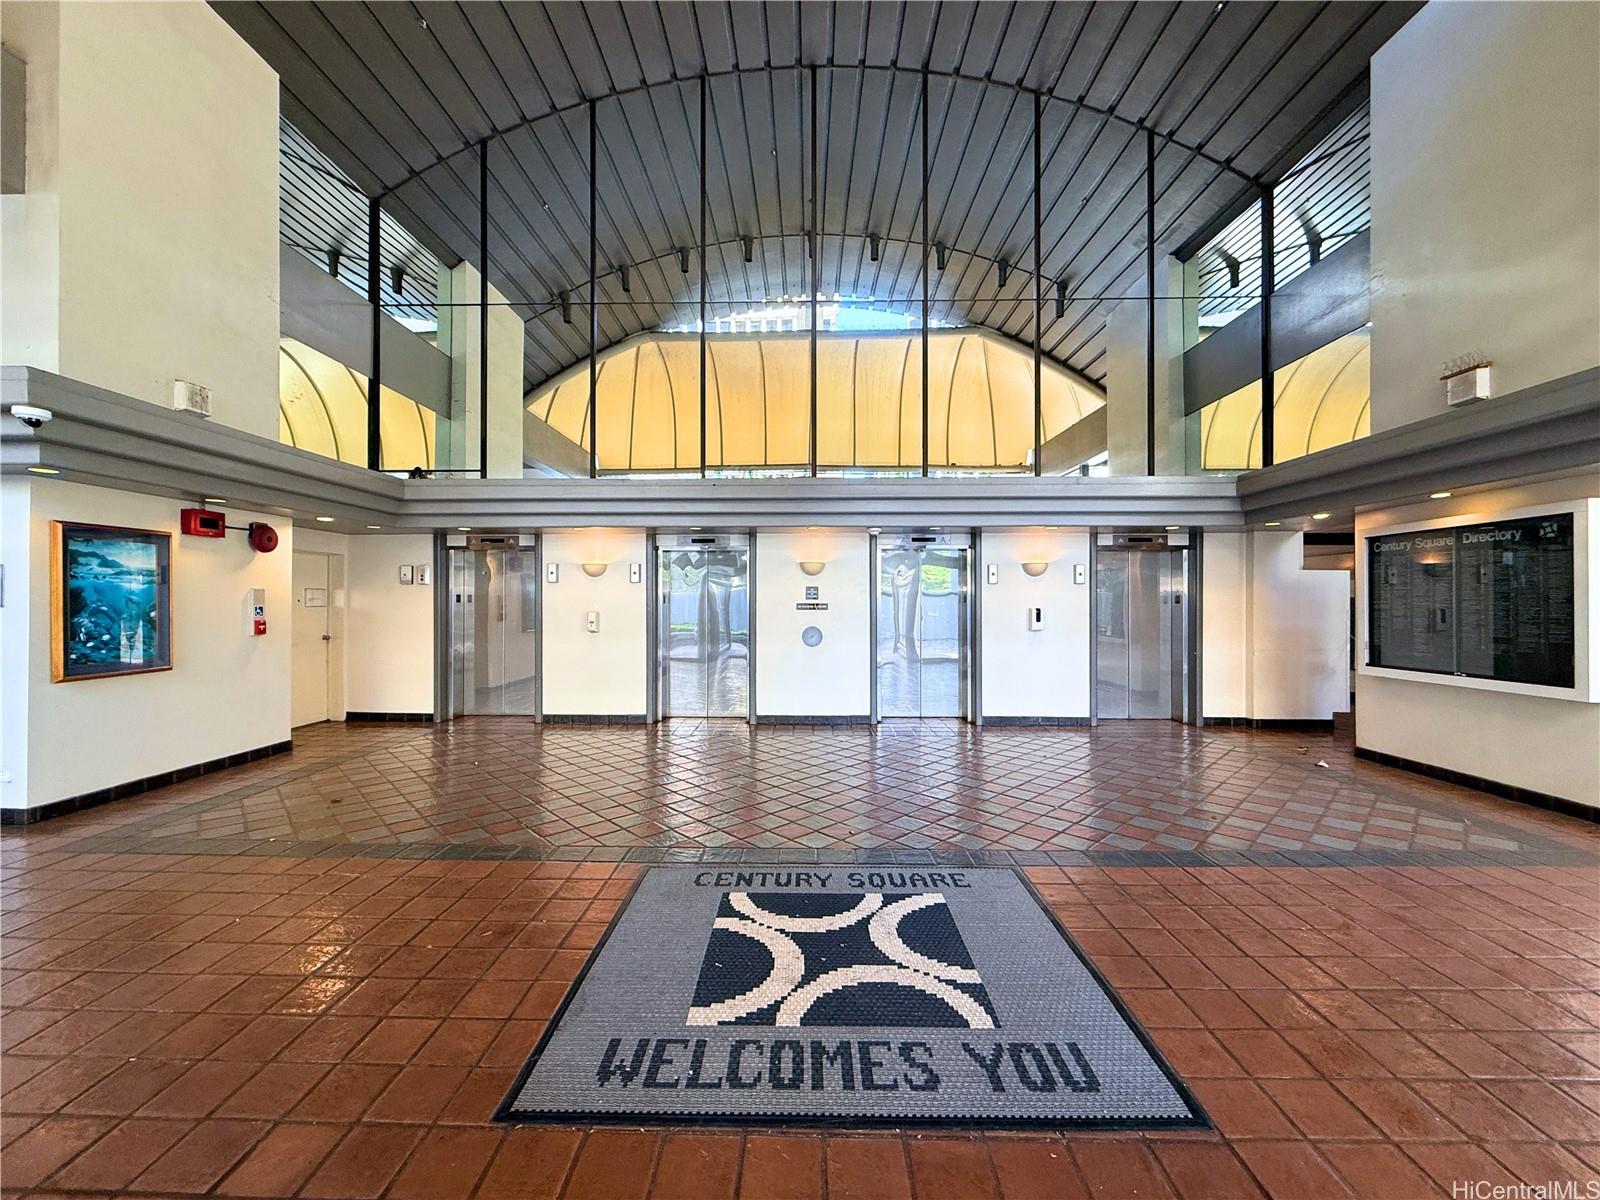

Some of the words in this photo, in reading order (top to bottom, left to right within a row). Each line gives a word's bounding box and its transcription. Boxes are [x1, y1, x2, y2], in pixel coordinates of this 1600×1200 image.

[1373, 540, 1412, 552] Century
[1414, 536, 1454, 549] Square
[1462, 529, 1521, 544] Directory
[694, 871, 832, 888] CENTURY
[848, 871, 971, 888] SQUARE
[598, 1037, 940, 1092] WELCOMES
[962, 1041, 1101, 1094] YOU
